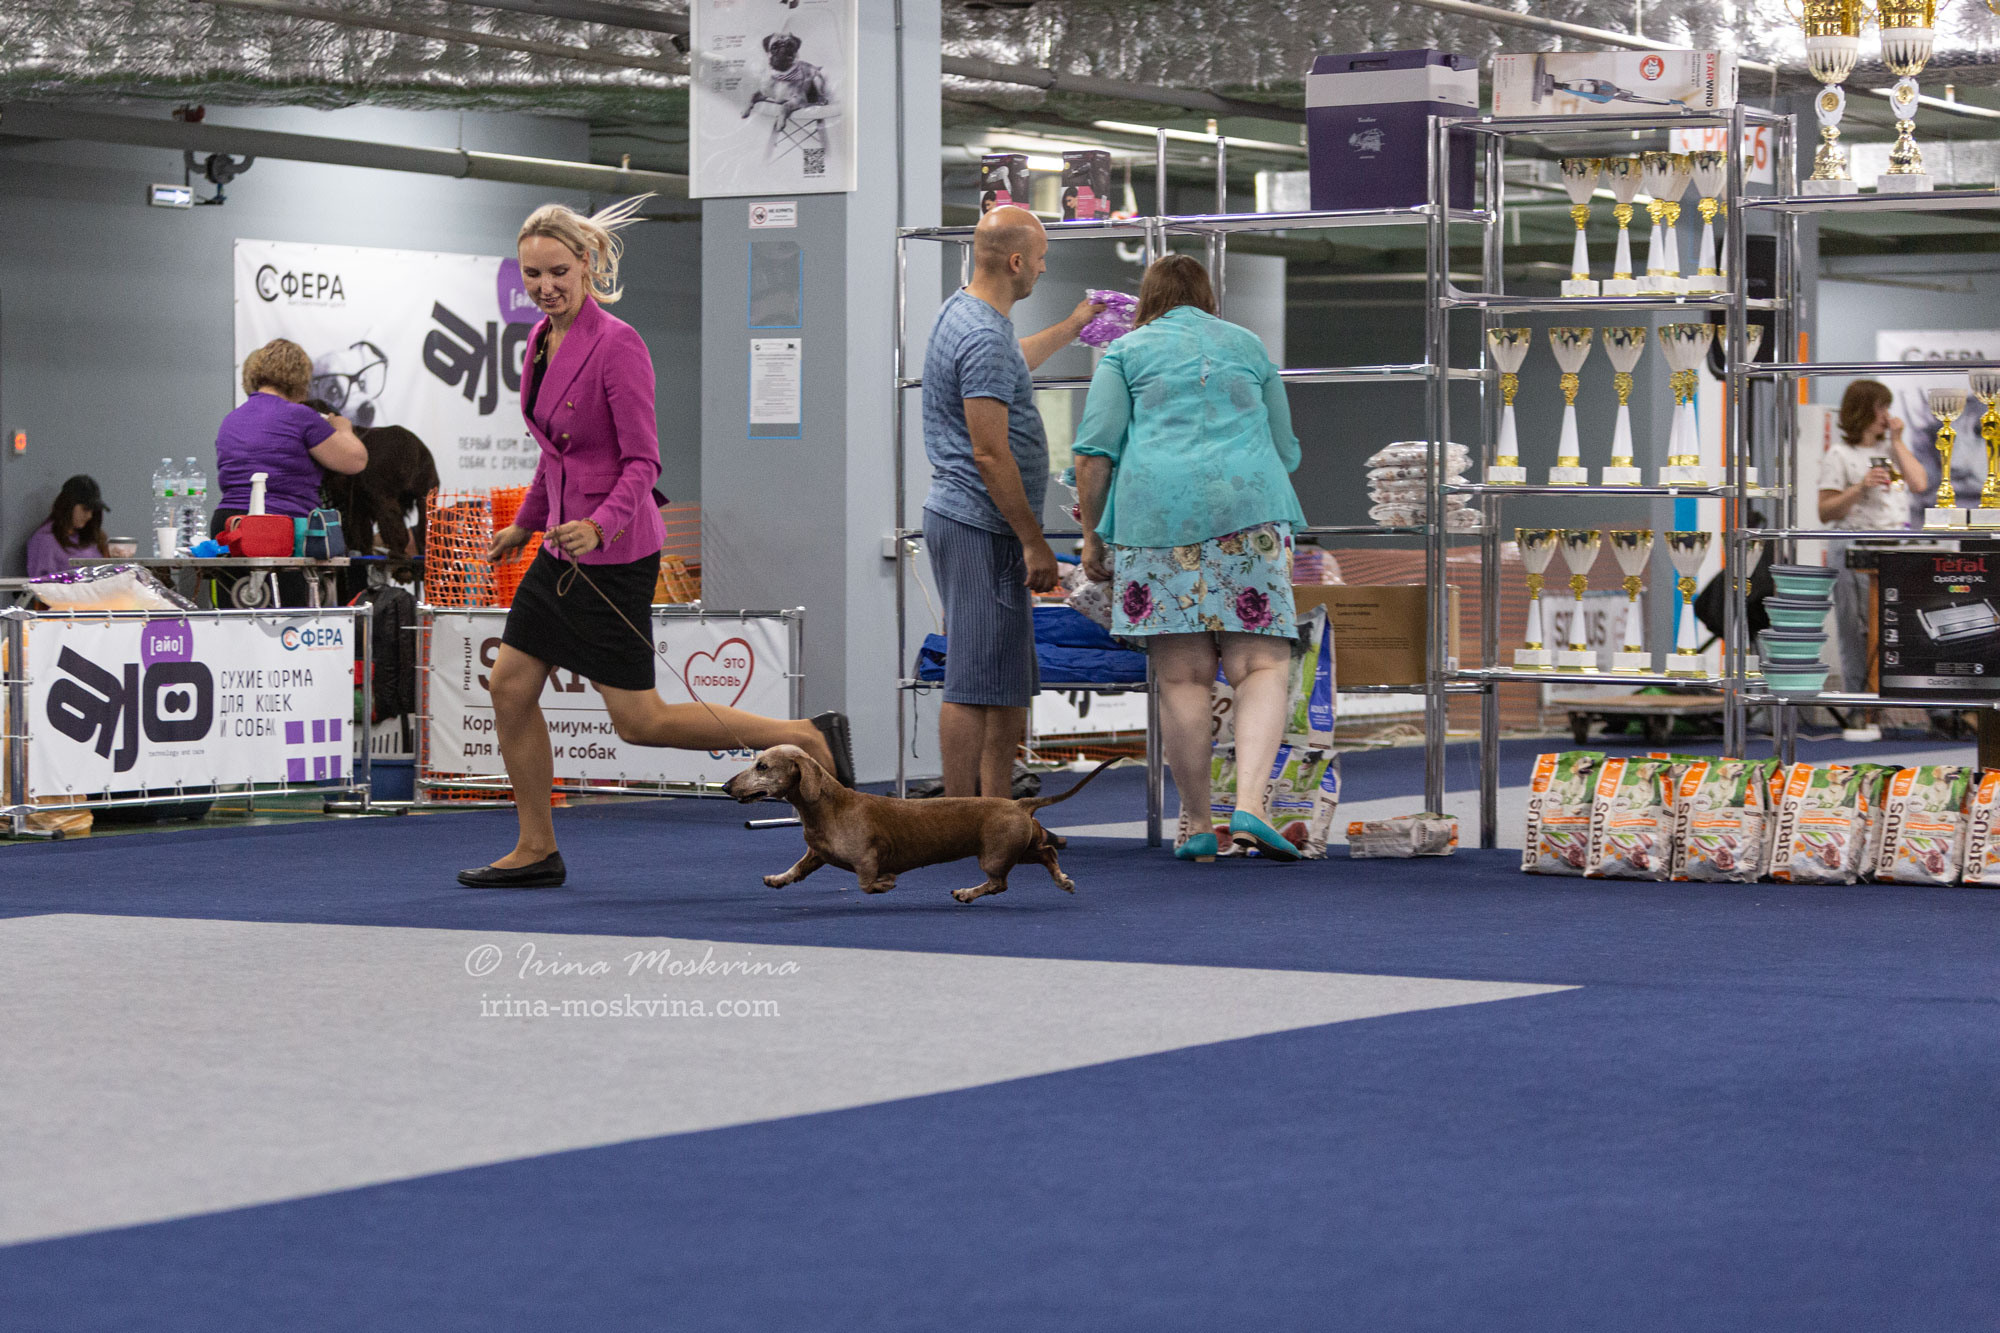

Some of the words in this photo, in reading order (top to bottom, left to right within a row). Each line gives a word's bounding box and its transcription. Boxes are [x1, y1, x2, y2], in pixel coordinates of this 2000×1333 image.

[1706, 53, 1715, 107] STARWIND
[256, 264, 345, 302] СФЕРА
[1932, 557, 1988, 572] Tefal
[281, 625, 344, 651] СФЕРА
[221, 670, 263, 689] СУХИЕ
[266, 668, 314, 688] КОРМА
[463, 637, 472, 691] PREMIUM
[723, 658, 746, 669] ЭТО
[692, 674, 741, 687] ЛЮБОВЬ
[220, 694, 244, 717] ДЛЯ
[256, 693, 293, 712] КОШЕК
[220, 719, 227, 737] И
[235, 718, 277, 737] СОБАК
[463, 715, 497, 734] Кор
[548, 721, 617, 738] миум-кл
[463, 743, 492, 757] для
[554, 747, 564, 758] и
[569, 743, 616, 760] собак
[1526, 797, 1543, 864] SIRIUS
[1590, 801, 1609, 866] SIRIUS
[1675, 802, 1691, 868] SIRIUS
[1775, 801, 1799, 864] SIRIUS
[1881, 801, 1904, 869] SIRIUS
[1968, 808, 1990, 875] SIRIUS
